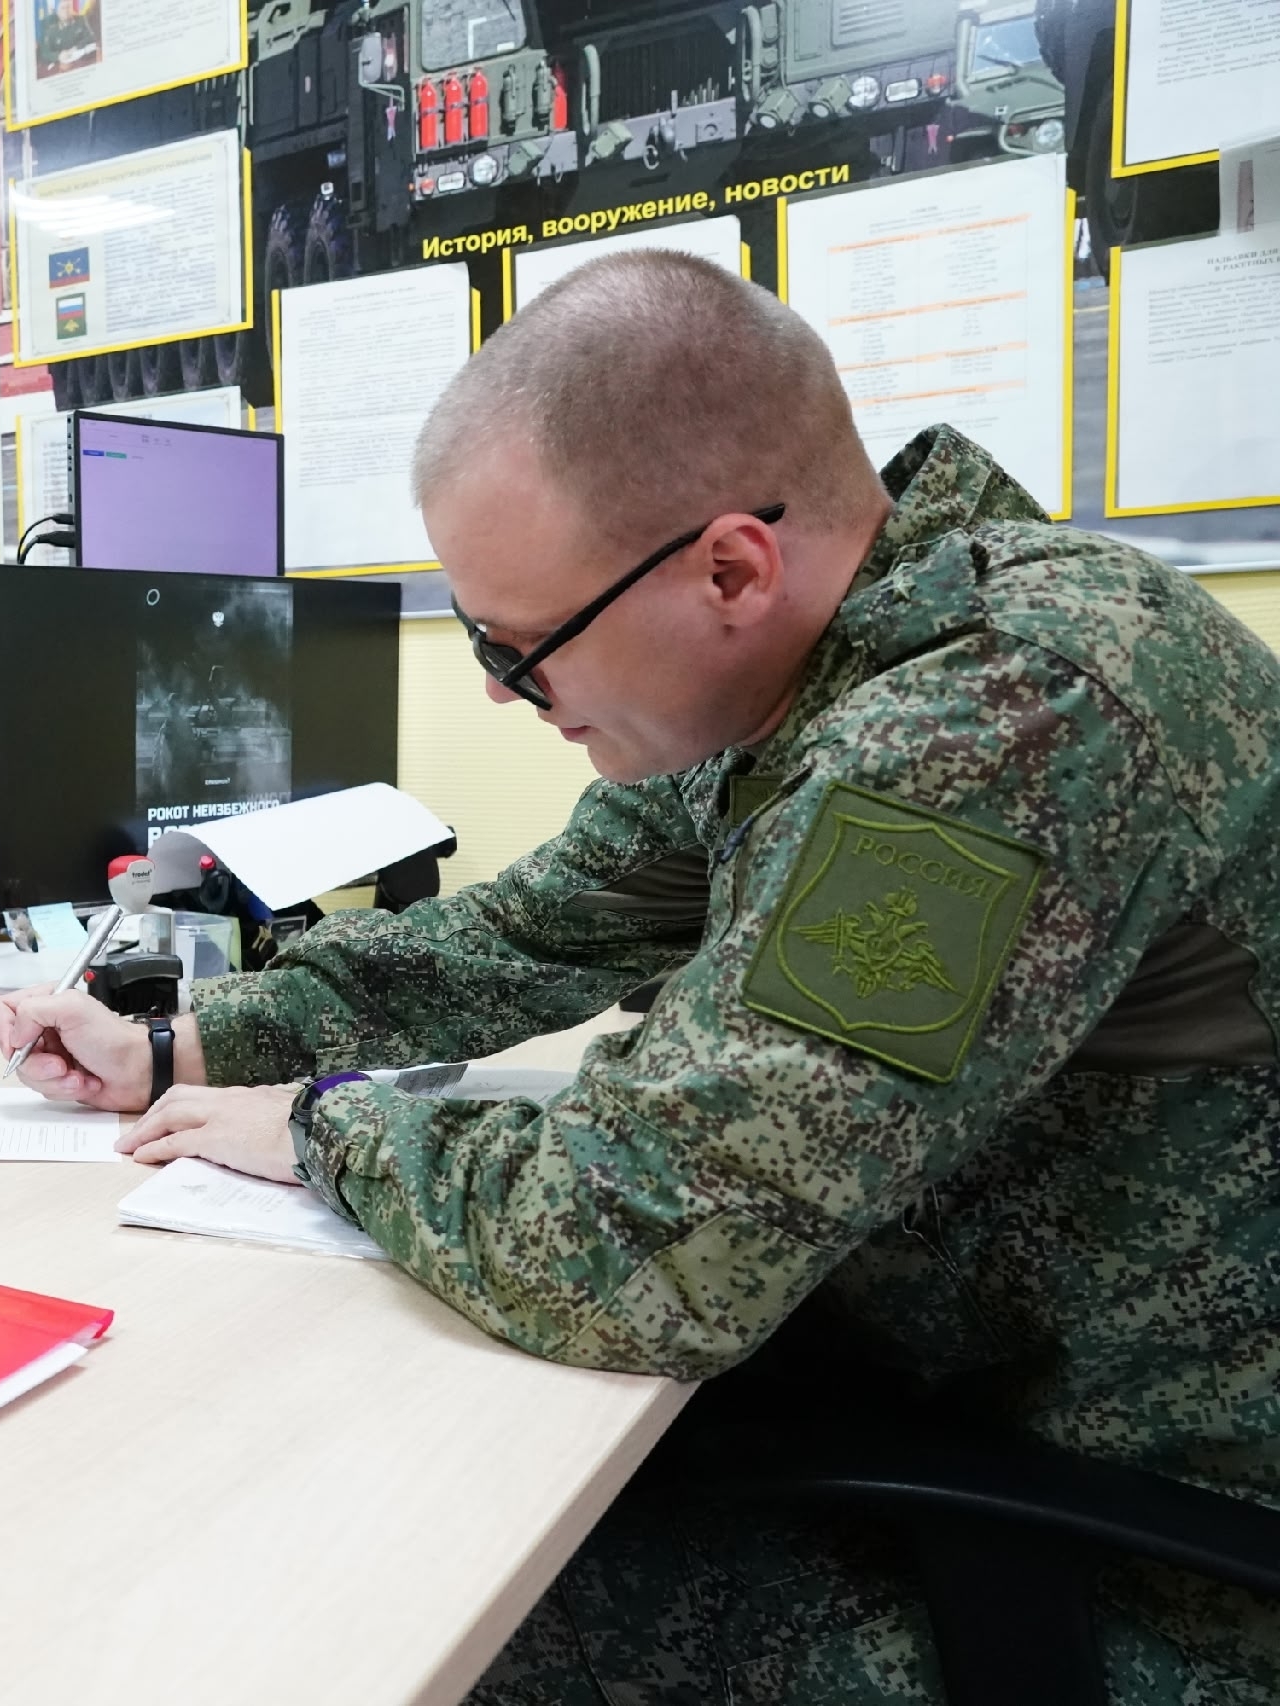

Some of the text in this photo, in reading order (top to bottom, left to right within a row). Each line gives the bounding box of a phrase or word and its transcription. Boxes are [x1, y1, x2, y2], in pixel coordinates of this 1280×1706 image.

[422, 164, 850, 259] История, вооружение, новости
[147, 805, 190, 822] РОКОТ
[851, 834, 988, 898] РОССИЯ
